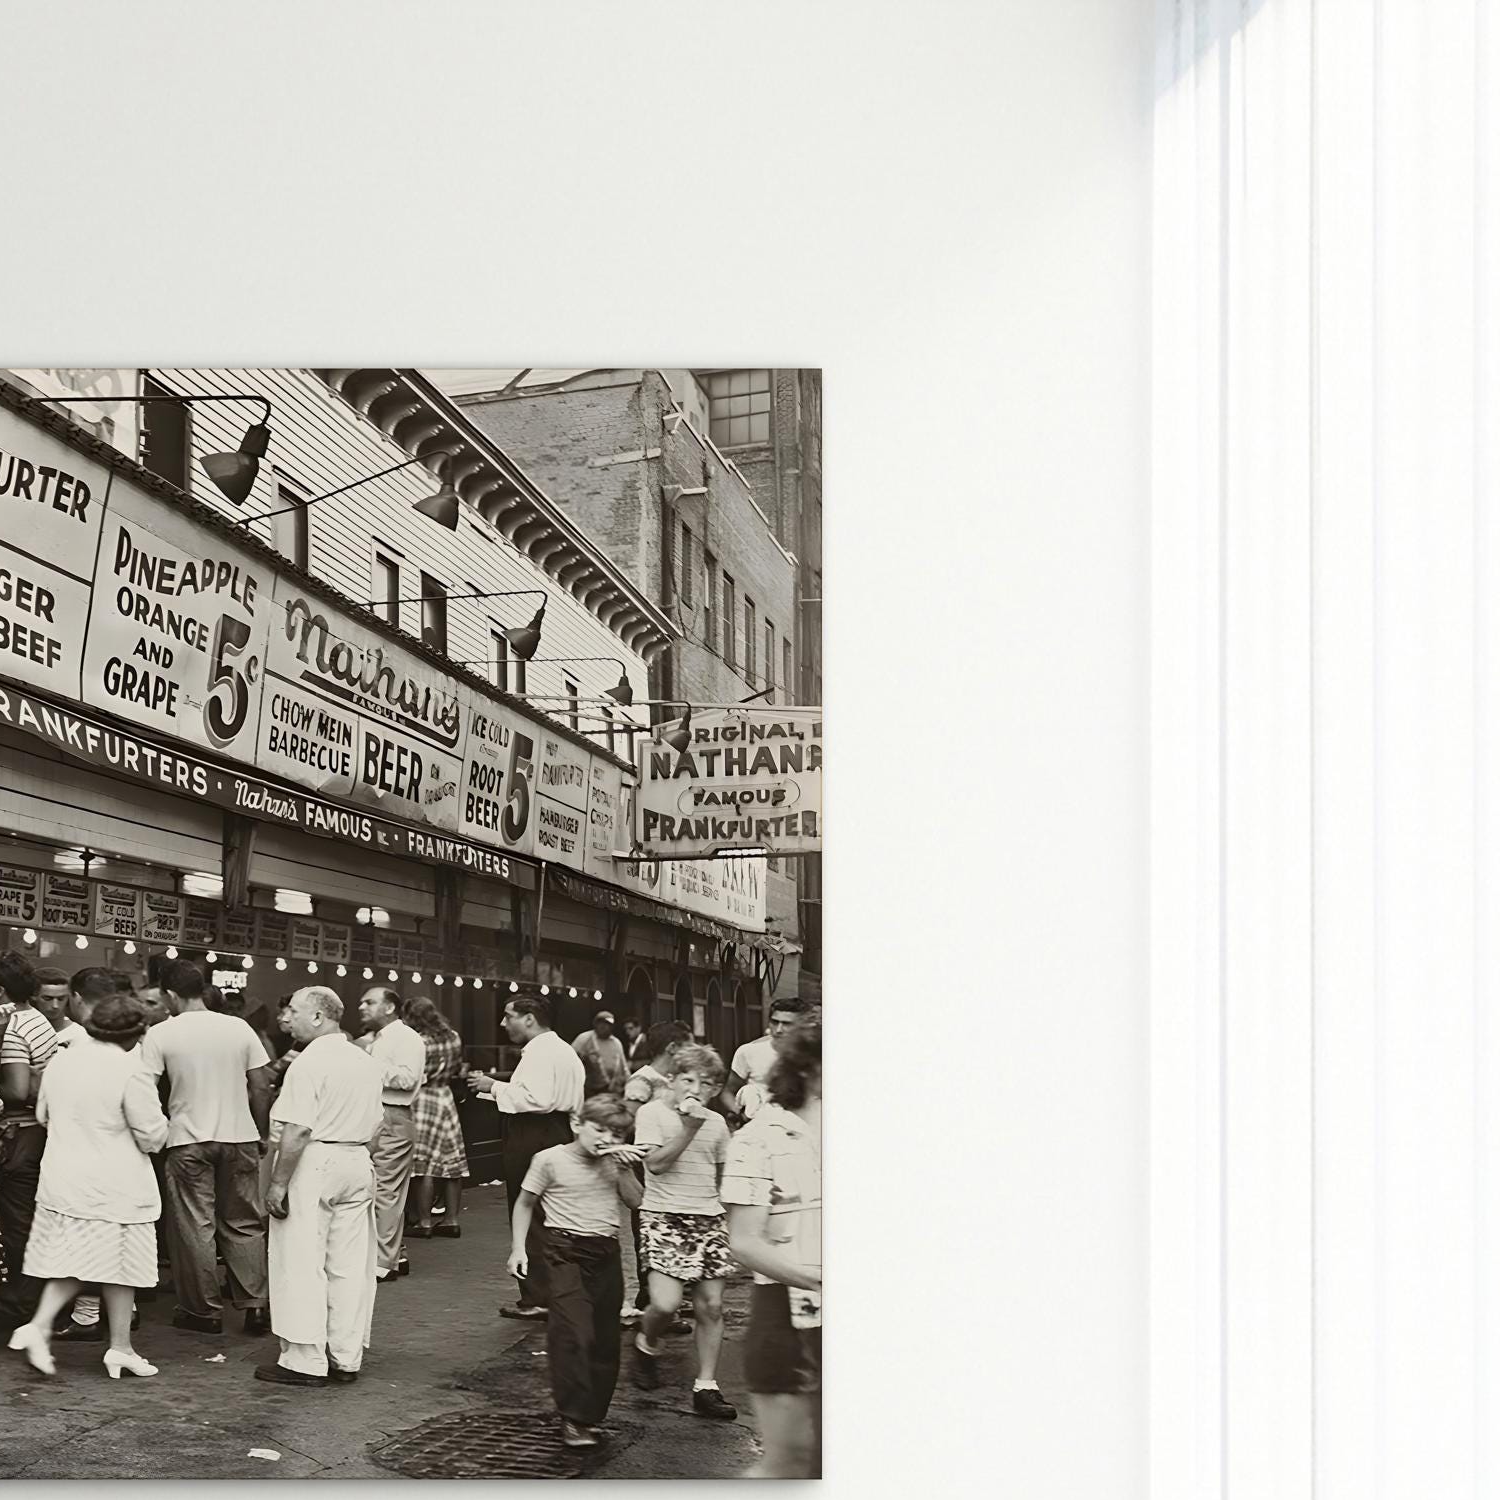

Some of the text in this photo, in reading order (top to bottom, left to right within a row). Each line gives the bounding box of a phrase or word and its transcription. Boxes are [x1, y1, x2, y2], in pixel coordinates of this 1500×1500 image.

[113, 525, 259, 618] PINEAPPLE
[116, 586, 210, 653] ORANGE
[132, 636, 174, 669] AND
[103, 656, 180, 718] GRAPE
[271, 694, 353, 748] CHOW MEIN
[471, 711, 488, 739] ICE
[694, 720, 805, 744] RIGINAL
[268, 726, 351, 777] BARBECUE
[362, 731, 423, 803] BEER
[468, 760, 505, 797] ROOT
[693, 788, 787, 807] FAMOUS
[465, 791, 500, 832] BEER
[305, 800, 372, 842] FAMOUS
[407, 831, 510, 878] FRANKFURTERS
[113, 918, 138, 936] BEER
